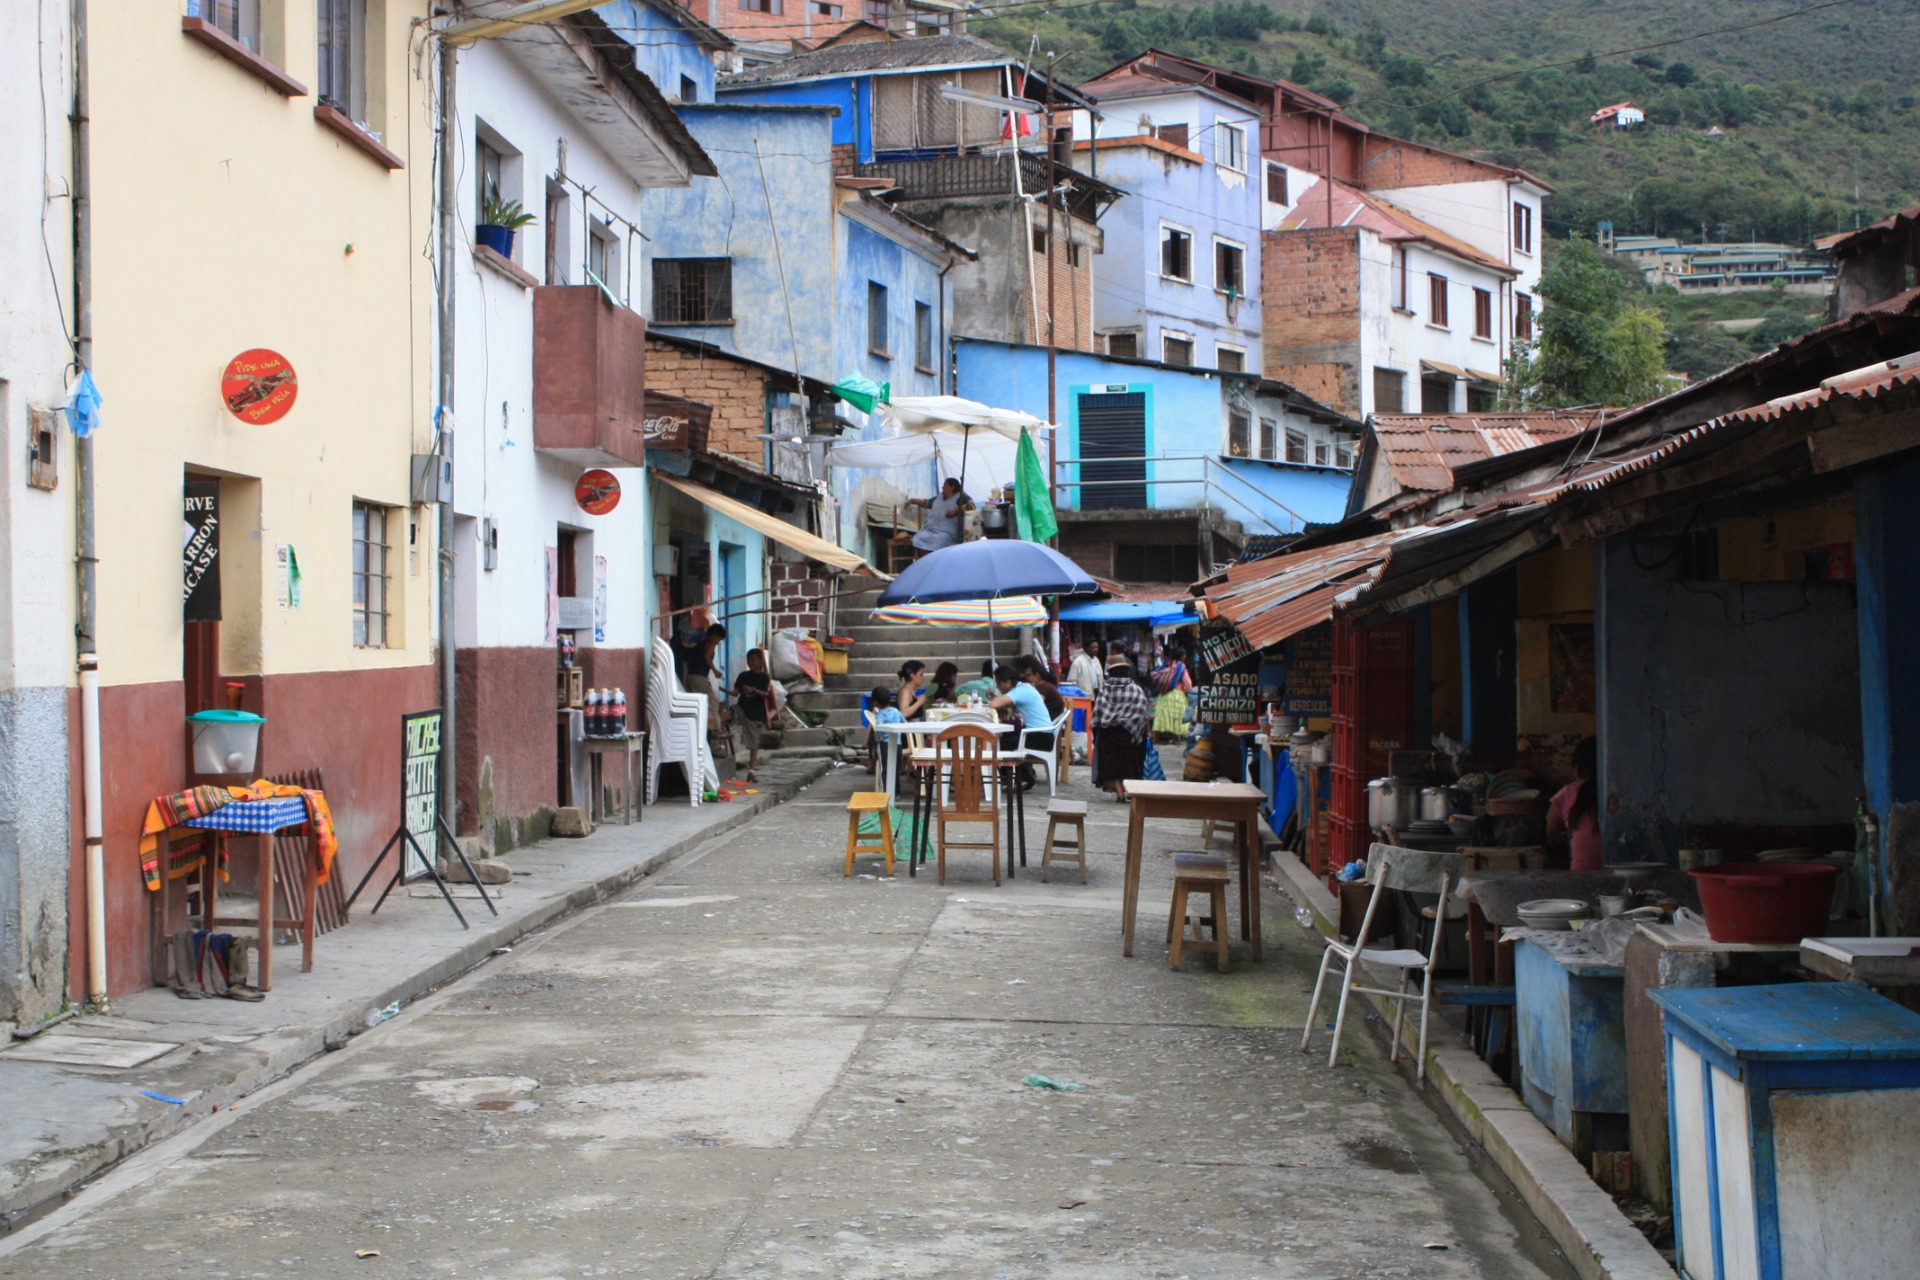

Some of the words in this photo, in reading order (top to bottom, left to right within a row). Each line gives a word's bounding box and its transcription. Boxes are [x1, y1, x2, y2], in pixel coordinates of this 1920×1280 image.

[644, 415, 682, 433] ca-Cola
[185, 496, 215, 511] RVE
[184, 514, 219, 572] ARRON
[1202, 631, 1227, 649] HOY
[1213, 672, 1258, 685] ASADO
[1286, 677, 1332, 686] DESAYUN
[1286, 687, 1332, 696] COMPLET
[1200, 698, 1256, 711] CHORIZO
[1201, 711, 1223, 723] POLLO
